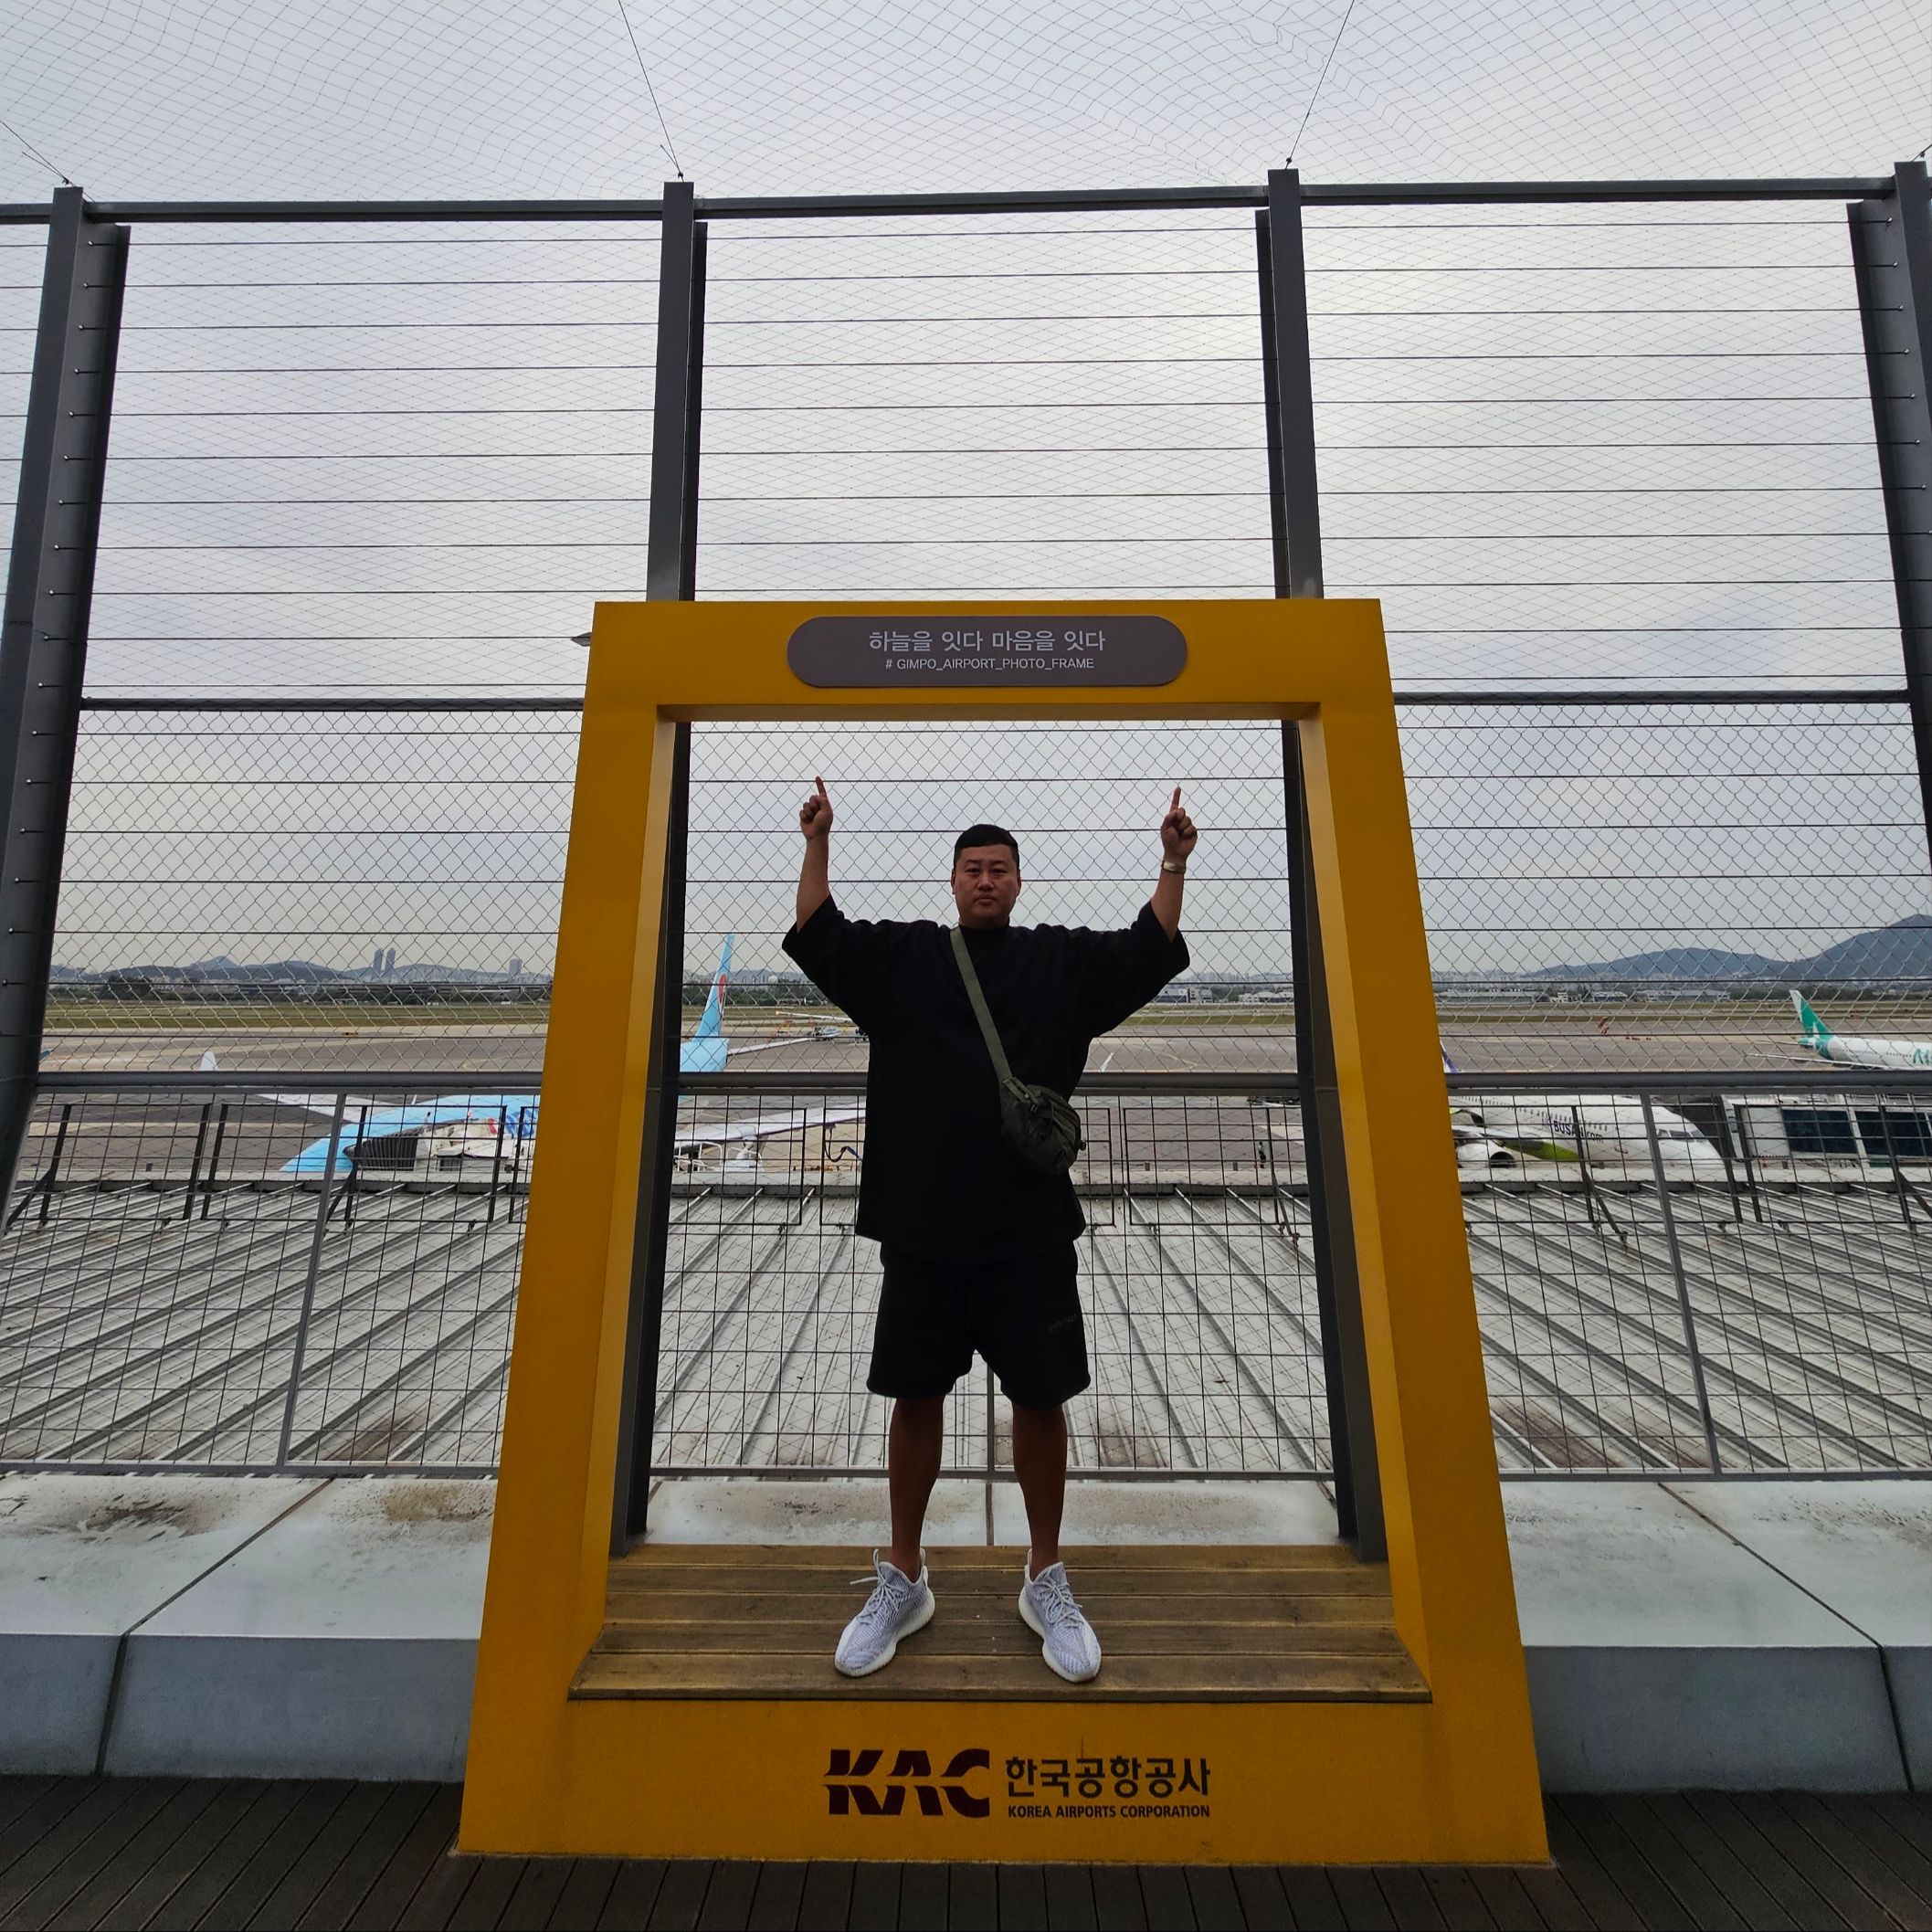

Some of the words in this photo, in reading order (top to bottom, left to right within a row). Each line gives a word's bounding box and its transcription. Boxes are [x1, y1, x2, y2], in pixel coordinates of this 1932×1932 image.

[869, 630, 933, 652] 하늘을
[941, 630, 984, 652] 잇다
[992, 630, 1055, 651] 마음을
[1064, 630, 1106, 651] 잇다
[896, 658, 1094, 670] GIMPO_AIRPORT_PHOTO_FRAME
[824, 1748, 990, 1818] KAC
[1006, 1756, 1210, 1799] 한국공항공사
[1008, 1805, 1051, 1818] KOREA
[1055, 1805, 1116, 1818] AIRPORTS
[1120, 1805, 1210, 1818] CORPORATION
